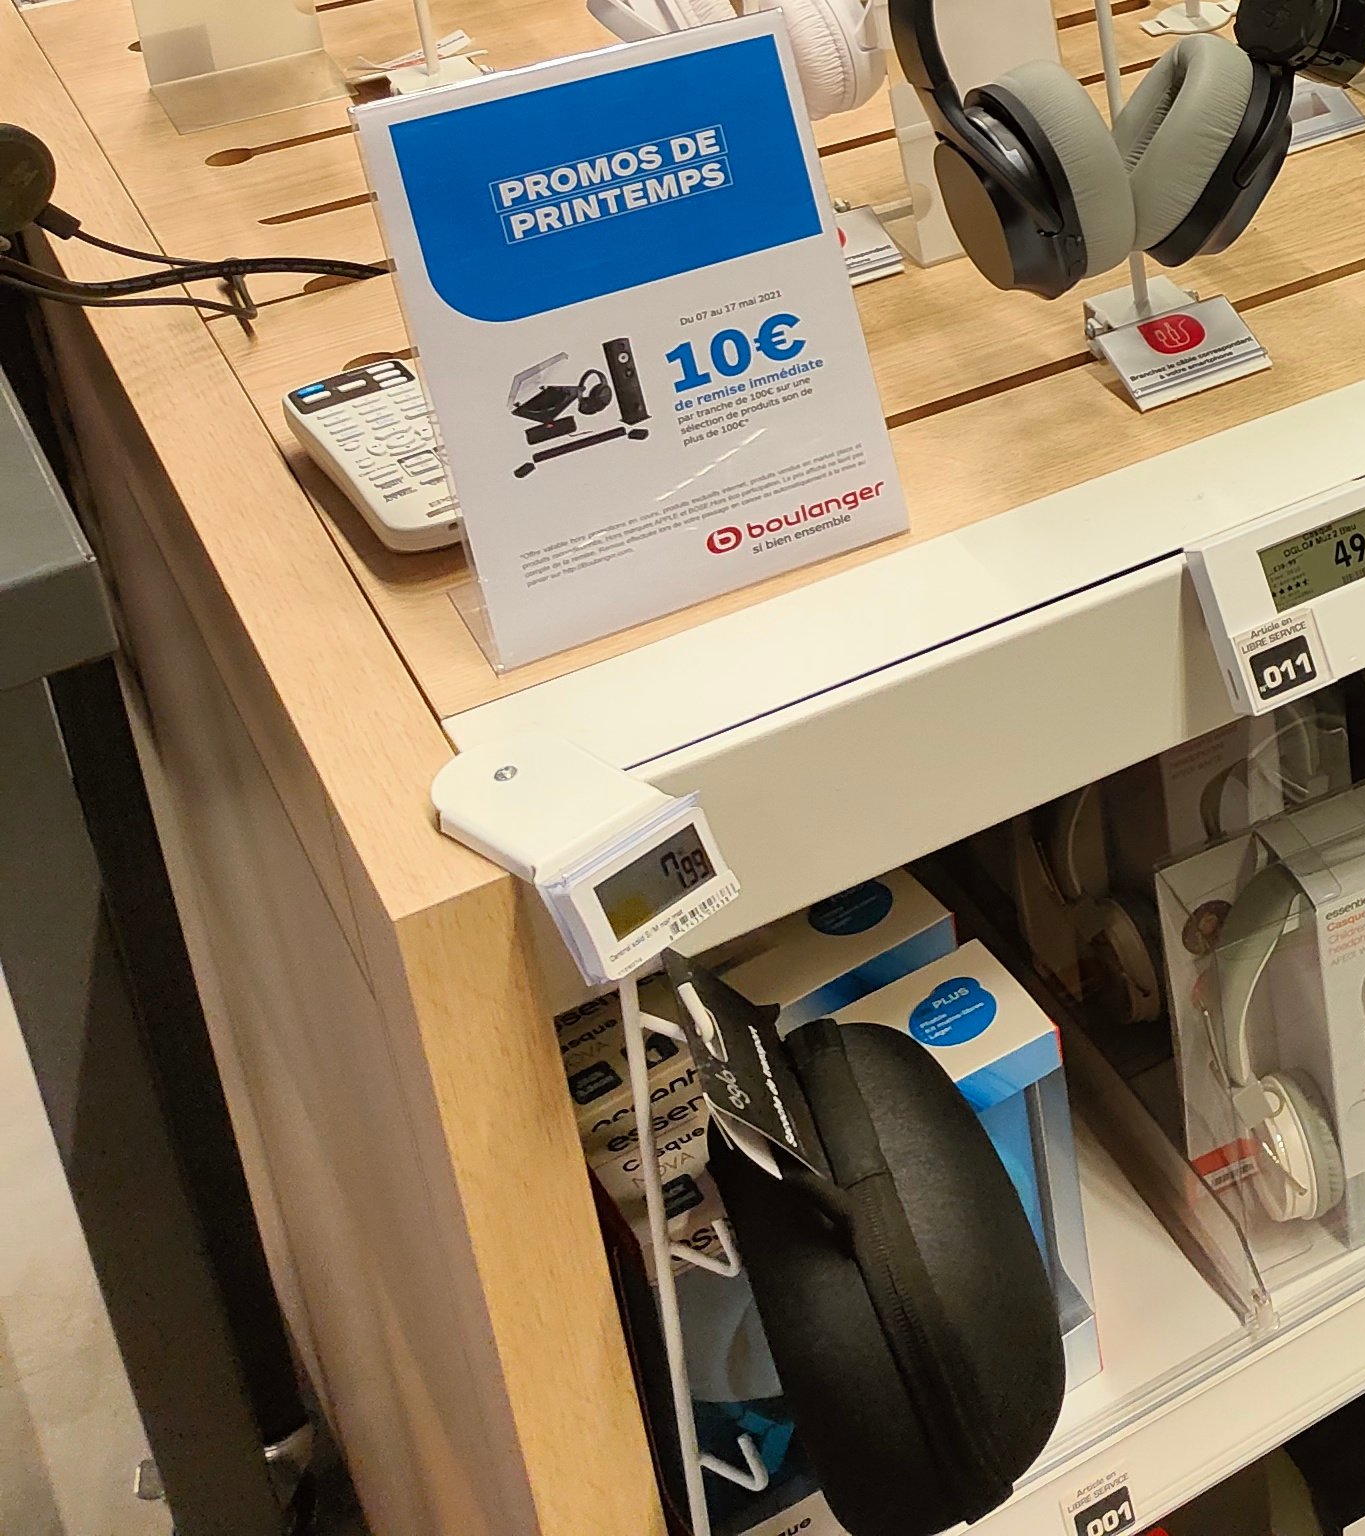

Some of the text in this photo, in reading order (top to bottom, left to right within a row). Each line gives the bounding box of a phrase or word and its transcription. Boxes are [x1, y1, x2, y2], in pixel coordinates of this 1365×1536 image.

[499, 129, 720, 207] PROMOS DE
[509, 163, 725, 239] PRINTEMPS
[680, 290, 781, 326] Du 07 au 17 mai 2021
[665, 313, 806, 392] 10€
[1130, 367, 1166, 381] Branchez
[1176, 356, 1197, 366] câble
[1198, 337, 1252, 358] correspondant
[675, 359, 823, 412] de remise immédiate
[678, 376, 811, 424] par tranche de 100€ sur une
[680, 387, 812, 434] sélection de produits son de
[684, 435, 704, 447] plus
[706, 428, 719, 437] de
[747, 481, 884, 539] boulanger
[752, 515, 851, 554] si bien ensemble
[1335, 533, 1365, 567] 49
[1241, 621, 1307, 654] LIBRE SERVICE
[1251, 617, 1292, 639] Article en
[932, 987, 969, 1009] PLUS
[1067, 1473, 1128, 1514] LIBRE SERVICE
[1076, 1470, 1116, 1498] Article en
